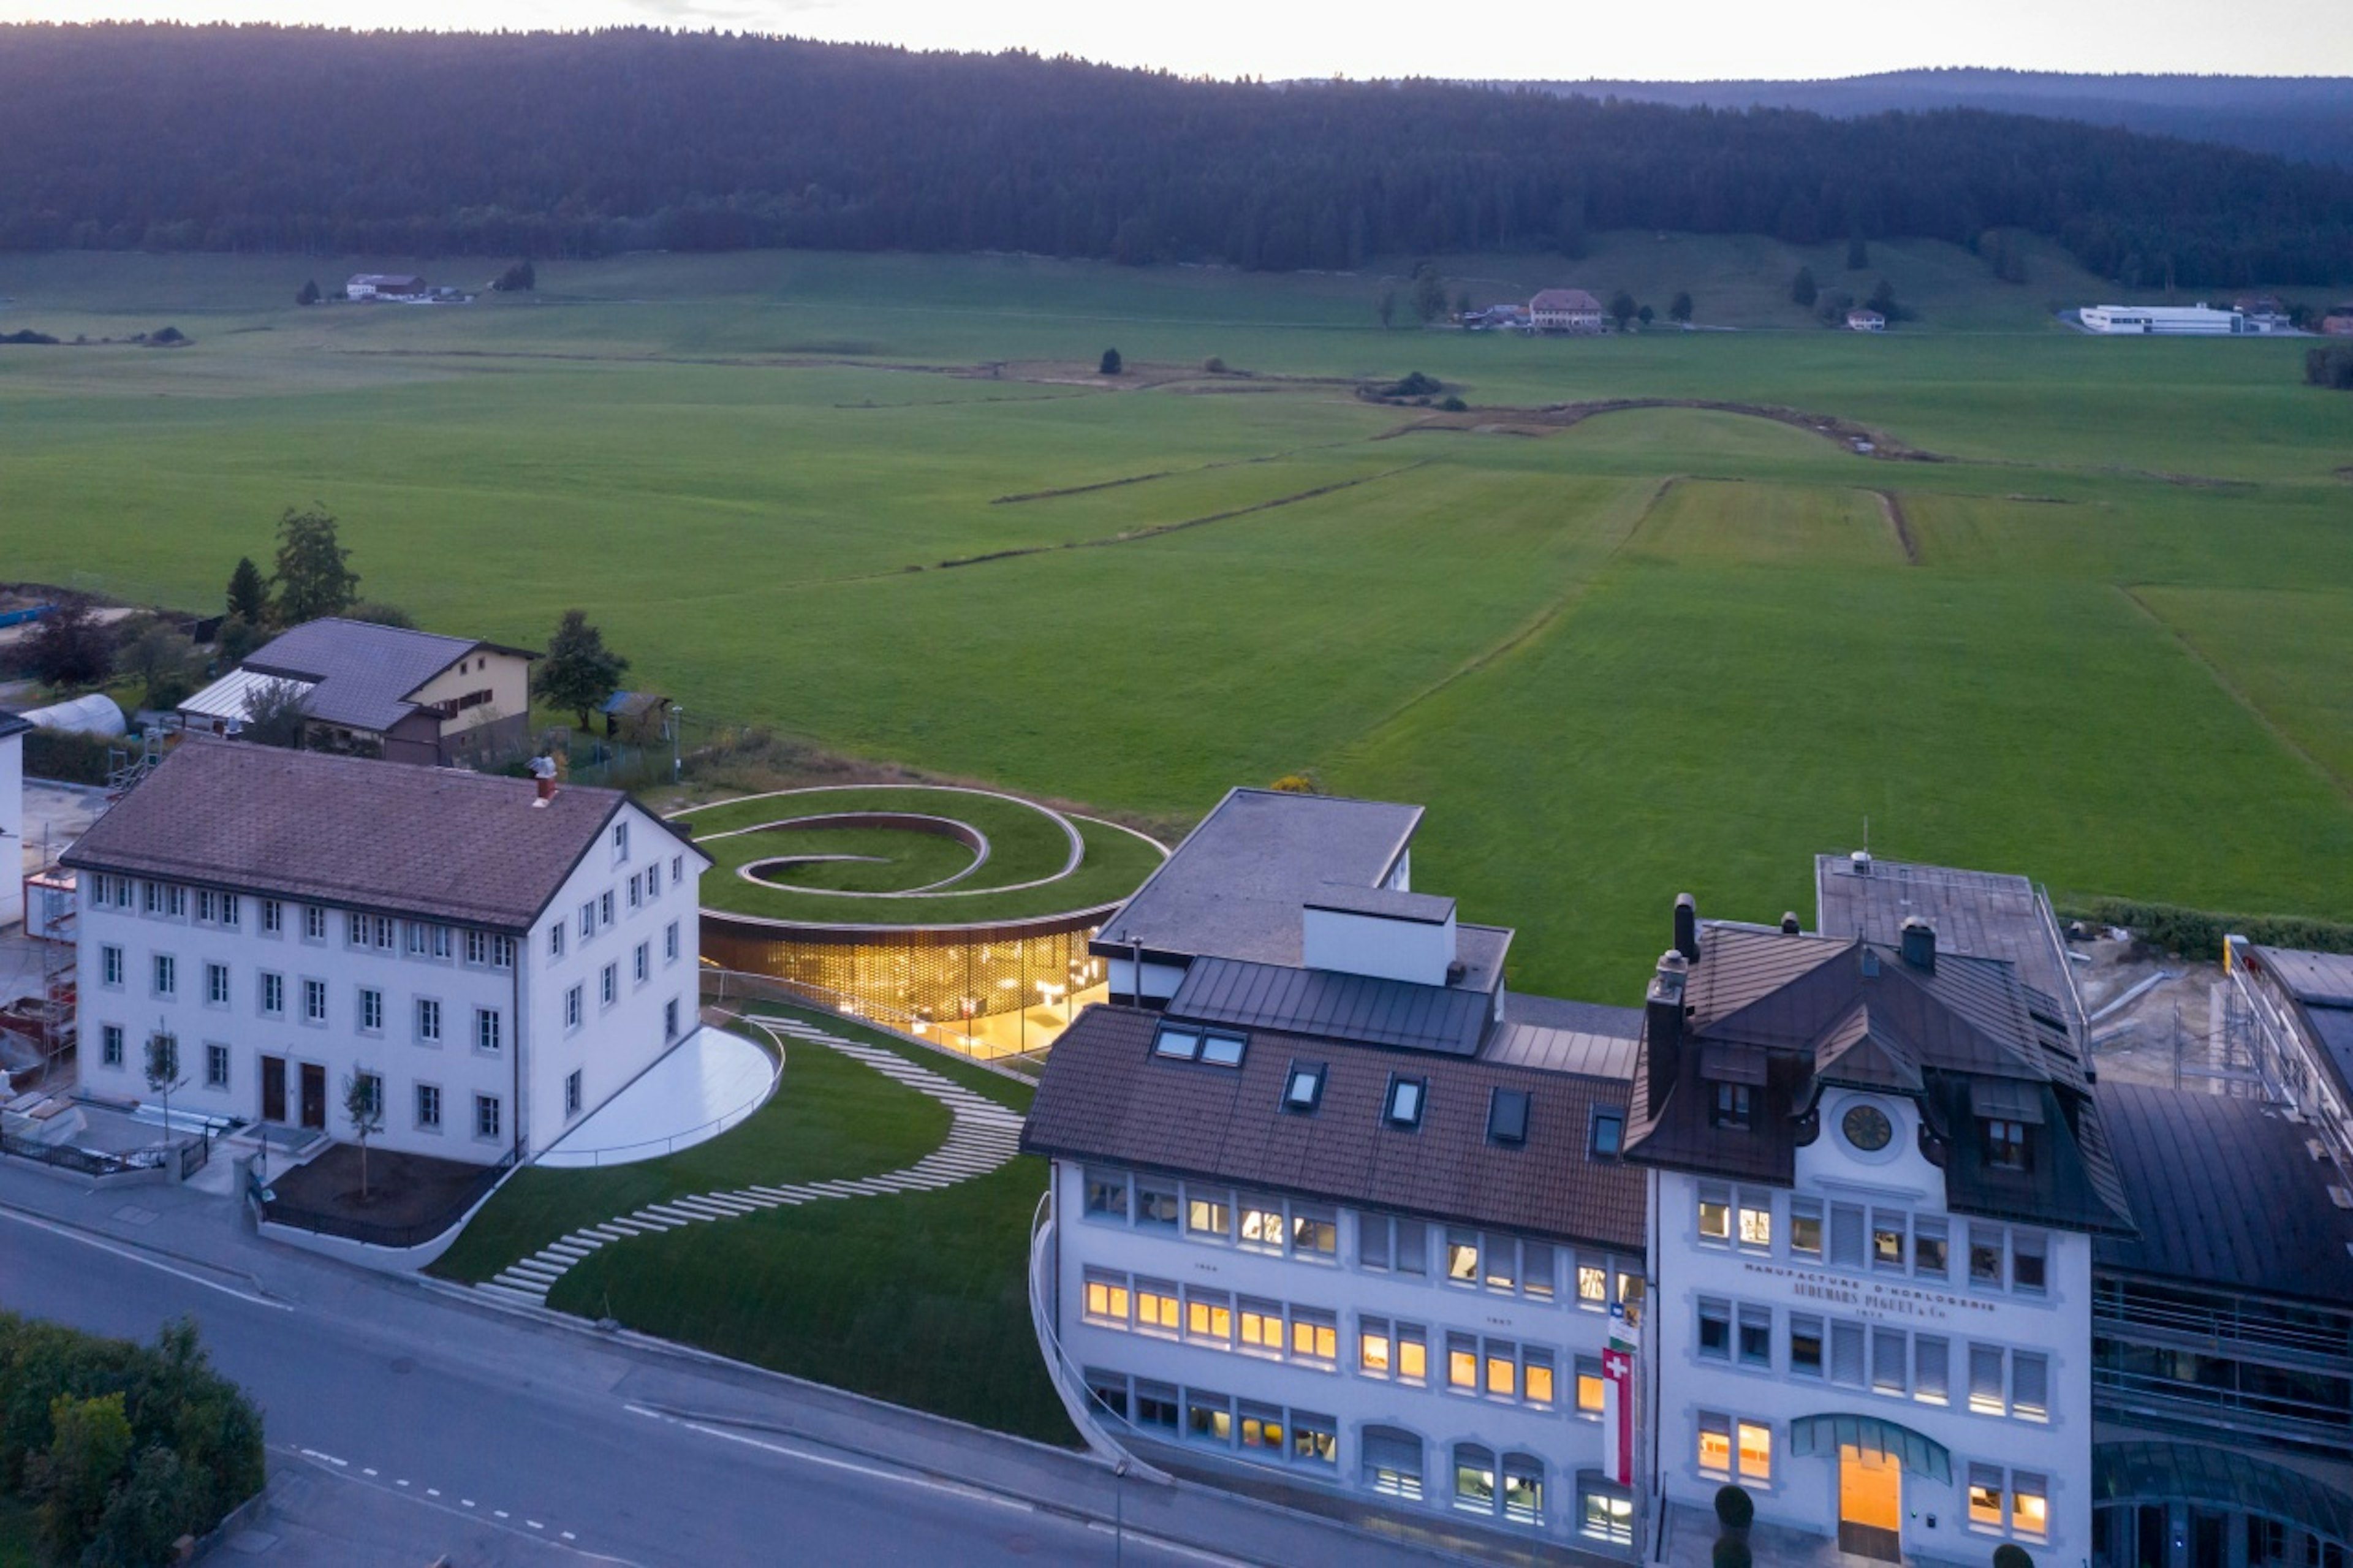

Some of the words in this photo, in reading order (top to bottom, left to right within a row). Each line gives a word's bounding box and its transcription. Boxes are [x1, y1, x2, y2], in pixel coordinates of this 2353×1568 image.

[1745, 1263, 1859, 1289] MANUFACTURE
[1794, 1282, 1858, 1305] AUDEMARS
[1865, 1293, 1912, 1315] PIGUET
